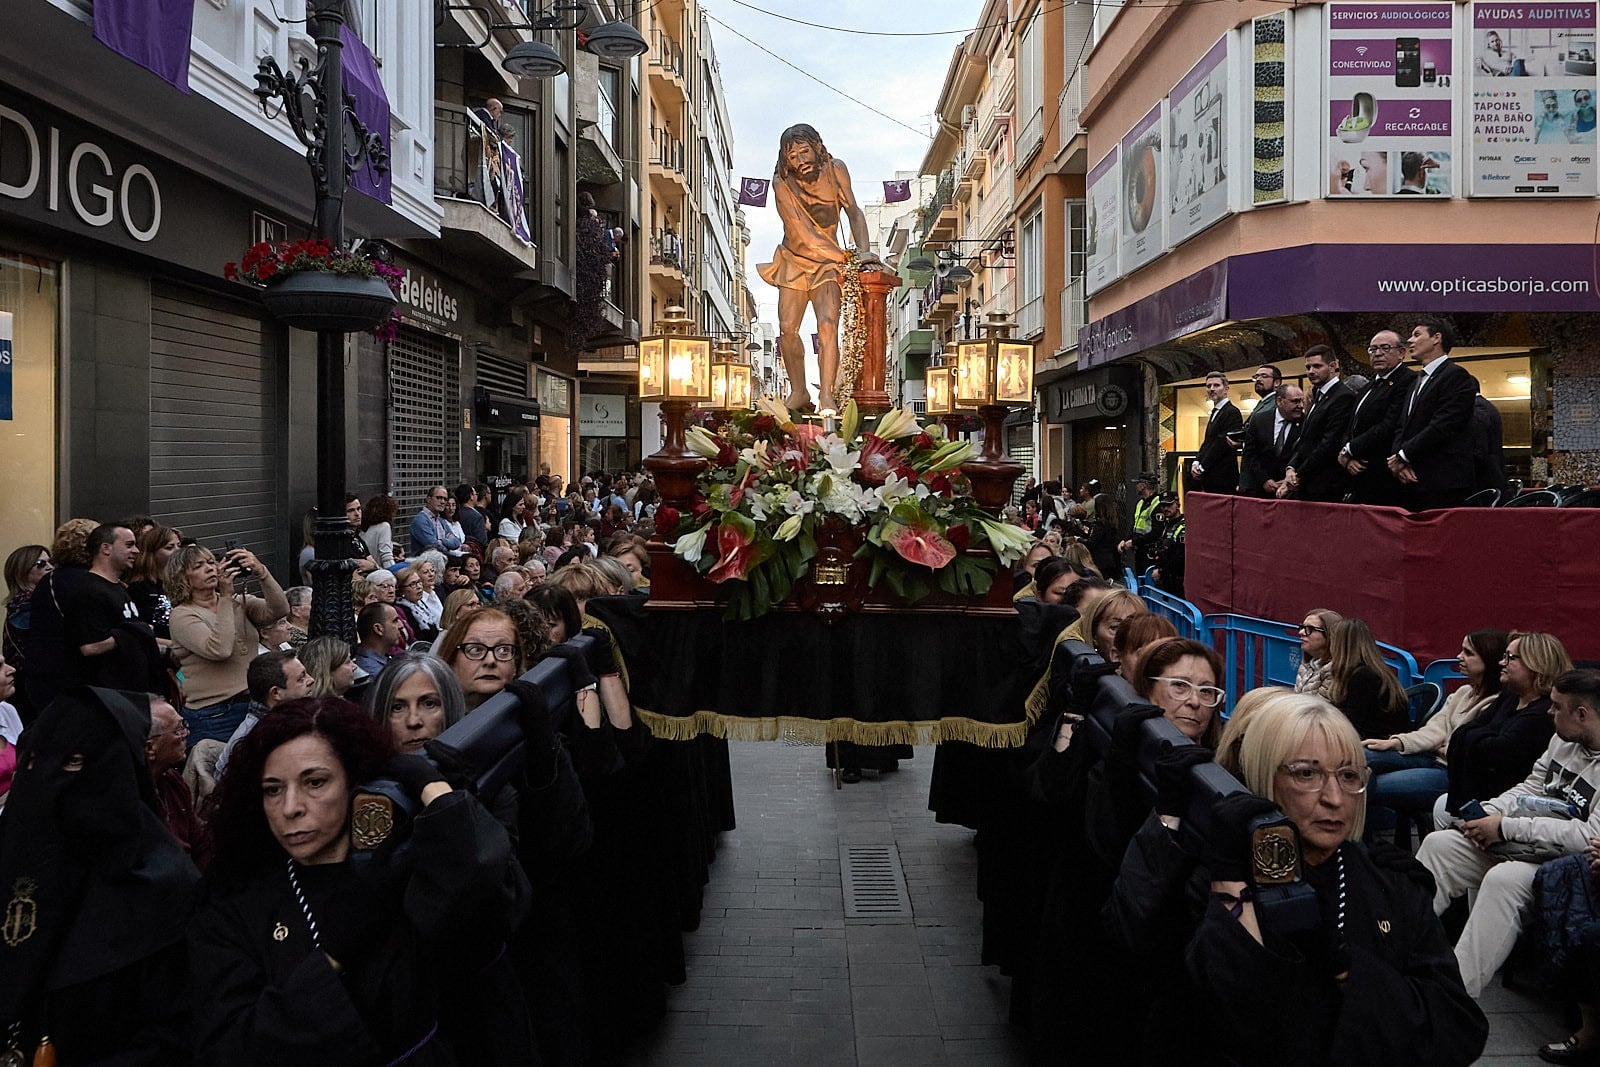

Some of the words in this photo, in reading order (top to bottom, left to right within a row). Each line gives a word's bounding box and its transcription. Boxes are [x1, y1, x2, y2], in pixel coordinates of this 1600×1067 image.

[1332, 11, 1378, 20] SERVICIOS
[1381, 9, 1450, 19] AUDIOLÓGICOS
[1477, 9, 1523, 19] AYUDAS
[1528, 8, 1591, 19] AUDITIVAS
[1332, 61, 1391, 69] CONECTIVIDAD
[1474, 102, 1521, 111] TAPONES
[1474, 114, 1499, 122] PARA
[1504, 112, 1533, 122] BAÑO
[1385, 123, 1448, 131] RECARGABLE
[1474, 126, 1481, 134] A
[1485, 126, 1525, 134] MEDIDA
[1377, 276, 1589, 296] www.opticasborja.com
[400, 269, 458, 321] deleites
